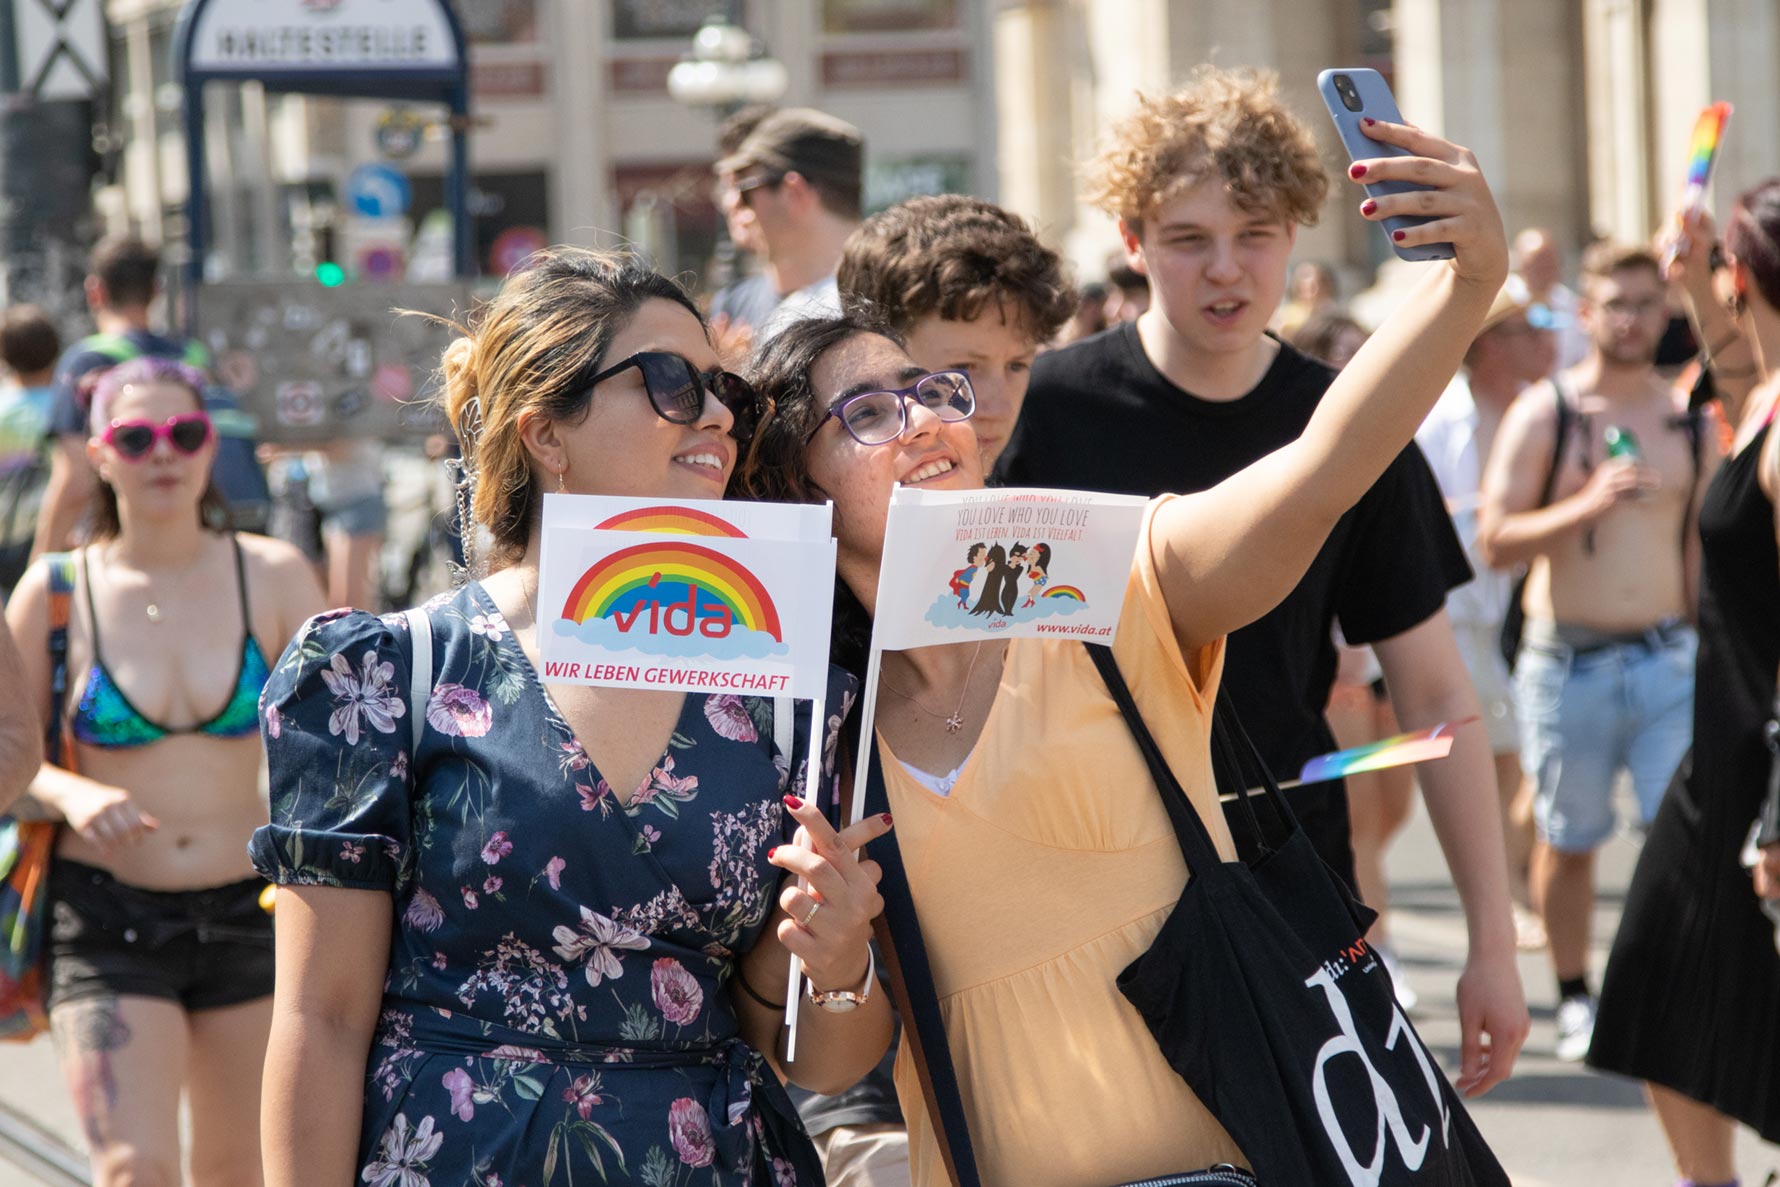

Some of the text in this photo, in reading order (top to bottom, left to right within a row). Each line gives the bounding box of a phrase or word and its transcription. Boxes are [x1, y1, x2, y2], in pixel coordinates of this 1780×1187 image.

[217, 24, 427, 54] HALTESTELLE
[958, 506, 1090, 527] YOU LOVE WHO YOU LOVE
[1036, 623, 1112, 636] www.vida.at
[545, 661, 790, 691] WIR LEBEN GEWERKSCHAFT
